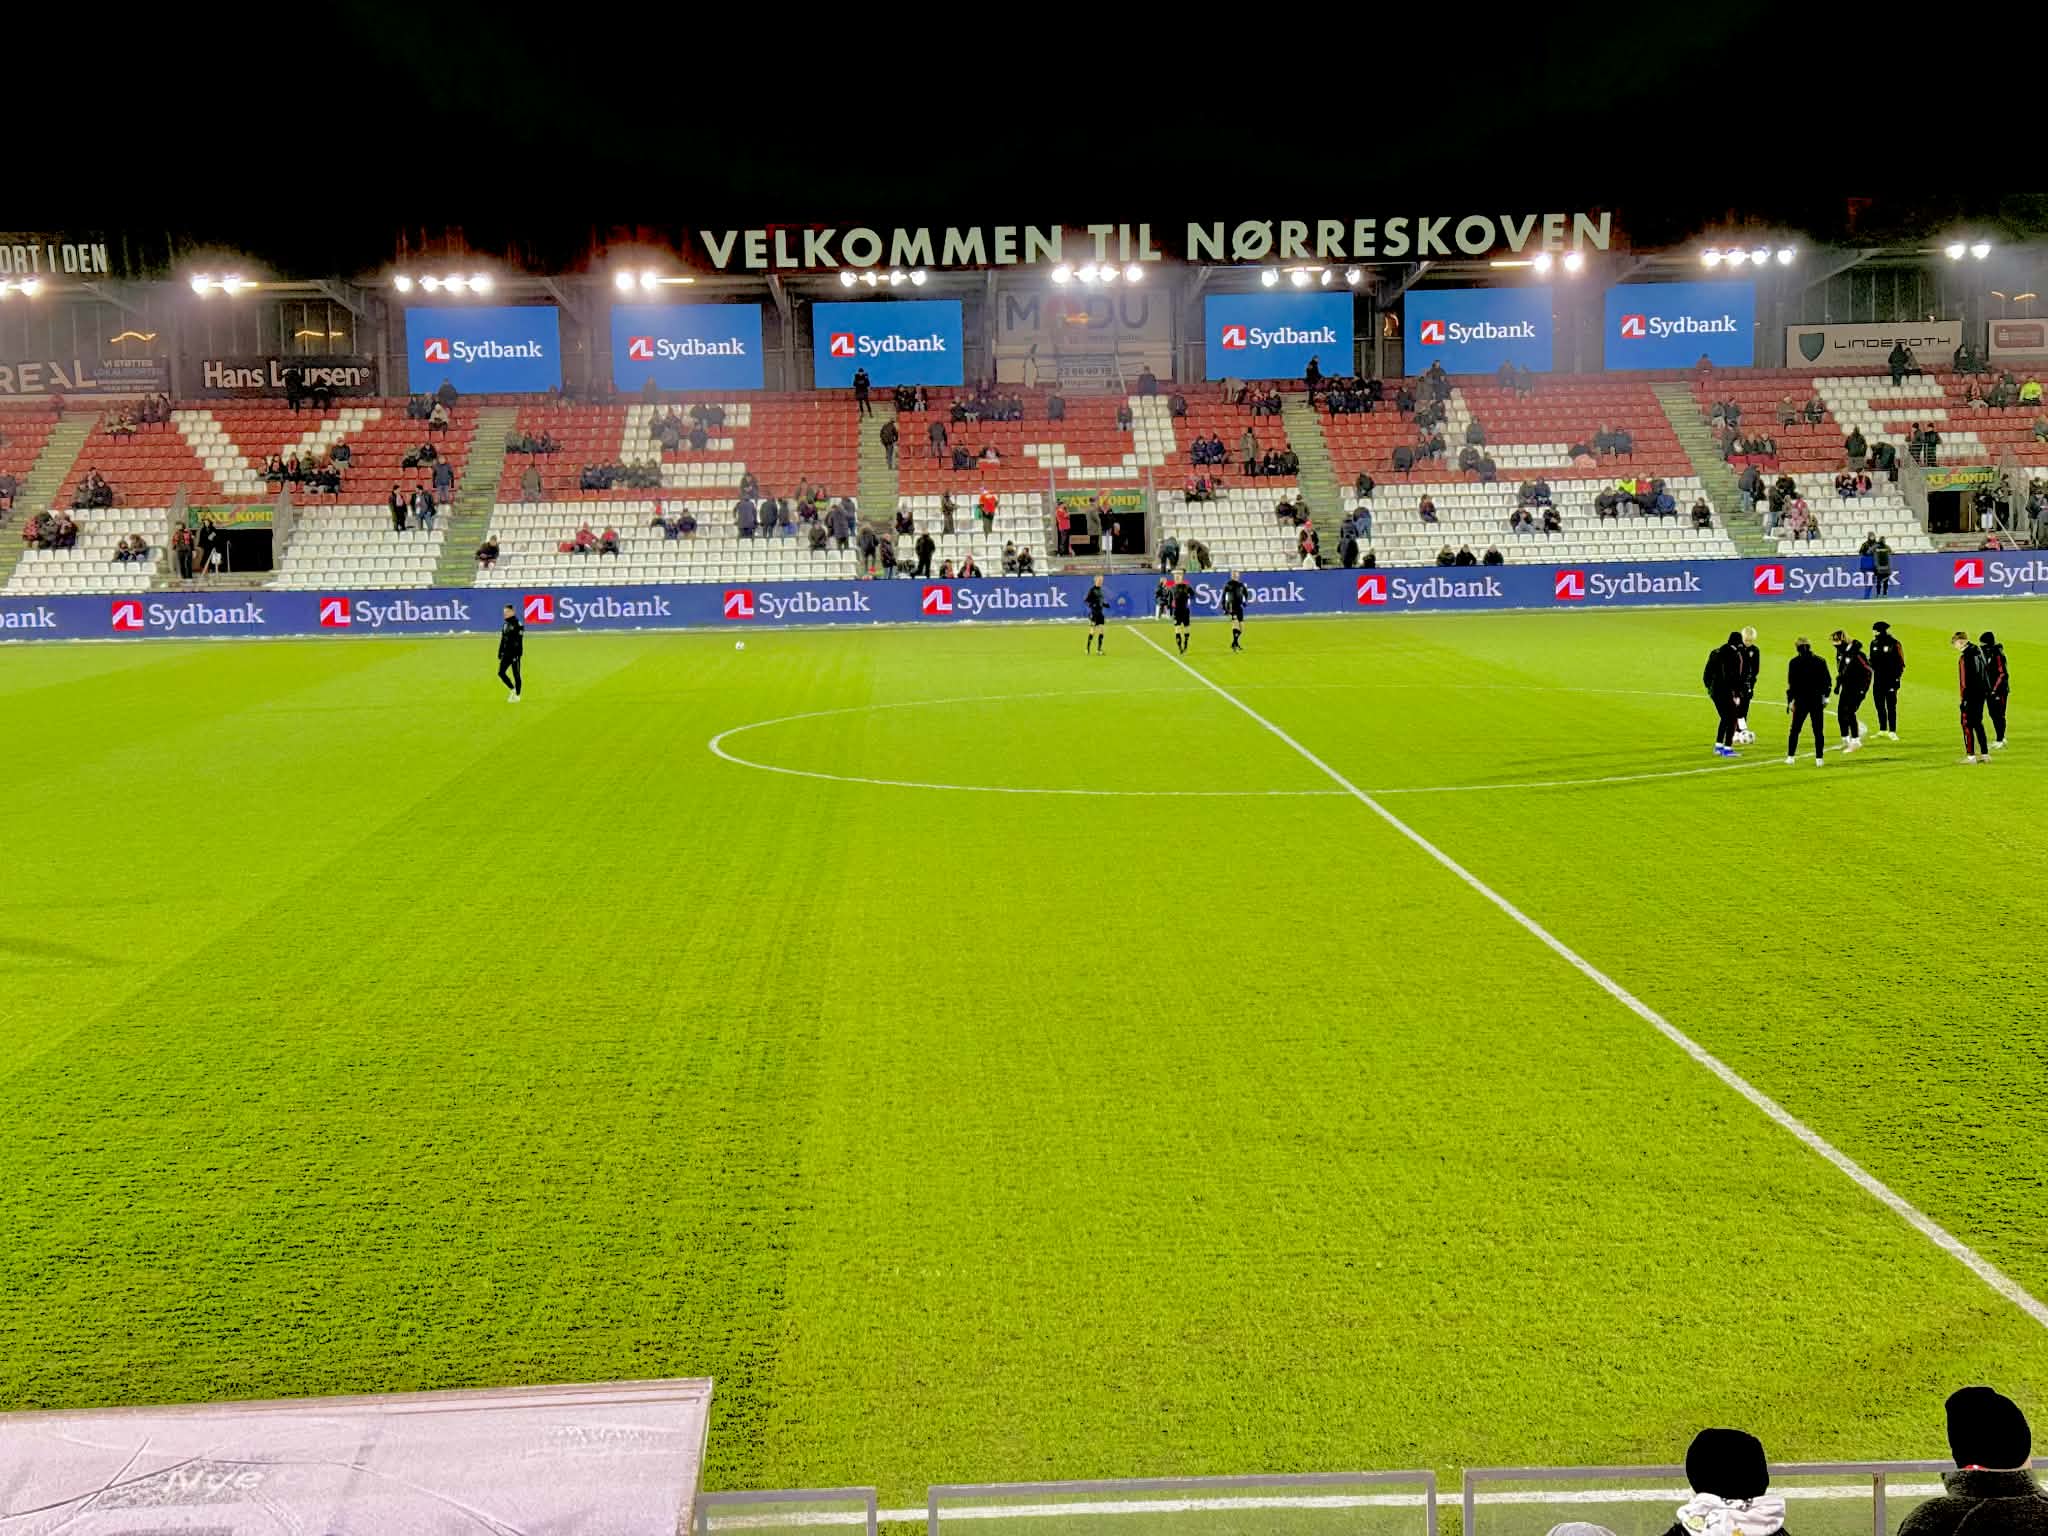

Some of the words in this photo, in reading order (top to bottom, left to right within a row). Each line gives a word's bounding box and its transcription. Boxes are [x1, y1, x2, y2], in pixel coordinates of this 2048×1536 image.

[700, 224, 1064, 268] VELKOMMEN
[1088, 222, 1162, 263] TIL
[1186, 211, 1612, 262] NØRRESKOVEN
[48, 245, 56, 273] I
[62, 243, 108, 273] DEN
[1249, 326, 1337, 349] Sydbank
[1449, 321, 1536, 344] Sydbank
[1645, 315, 1737, 338] Sydbank
[452, 340, 543, 363] Sydbank
[656, 337, 745, 361] Sydbank
[858, 334, 945, 357] Sydbank
[202, 360, 264, 388] Hans
[1195, 581, 1305, 609] Sybank
[1391, 576, 1503, 604] Sydbank
[1590, 571, 1701, 600] Sydbank
[355, 599, 470, 627] Sydbank
[559, 595, 671, 623] Sydbank
[759, 591, 871, 619] Sydbank
[957, 586, 1068, 615] Sydbank
[148, 603, 265, 631] Sydbank
